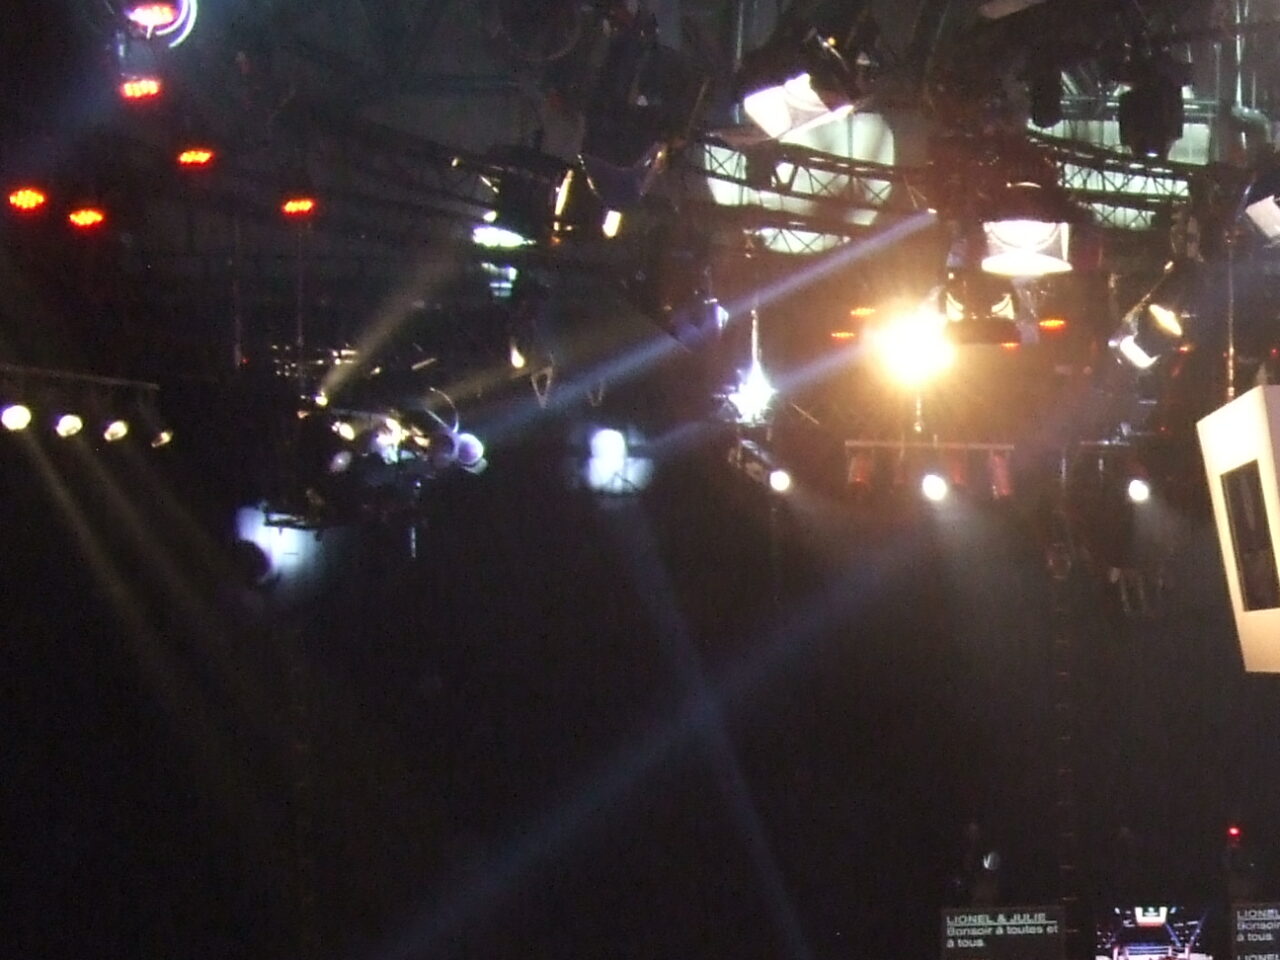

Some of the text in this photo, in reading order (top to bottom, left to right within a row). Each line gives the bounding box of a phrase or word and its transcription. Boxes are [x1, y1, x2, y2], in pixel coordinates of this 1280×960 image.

[946, 912, 1046, 926] LIONEL & JULIE
[1237, 920, 1280, 930] Bonsoir
[946, 926, 992, 936] Bonsoir
[1007, 924, 1043, 935] toutes
[1046, 924, 1058, 934] et
